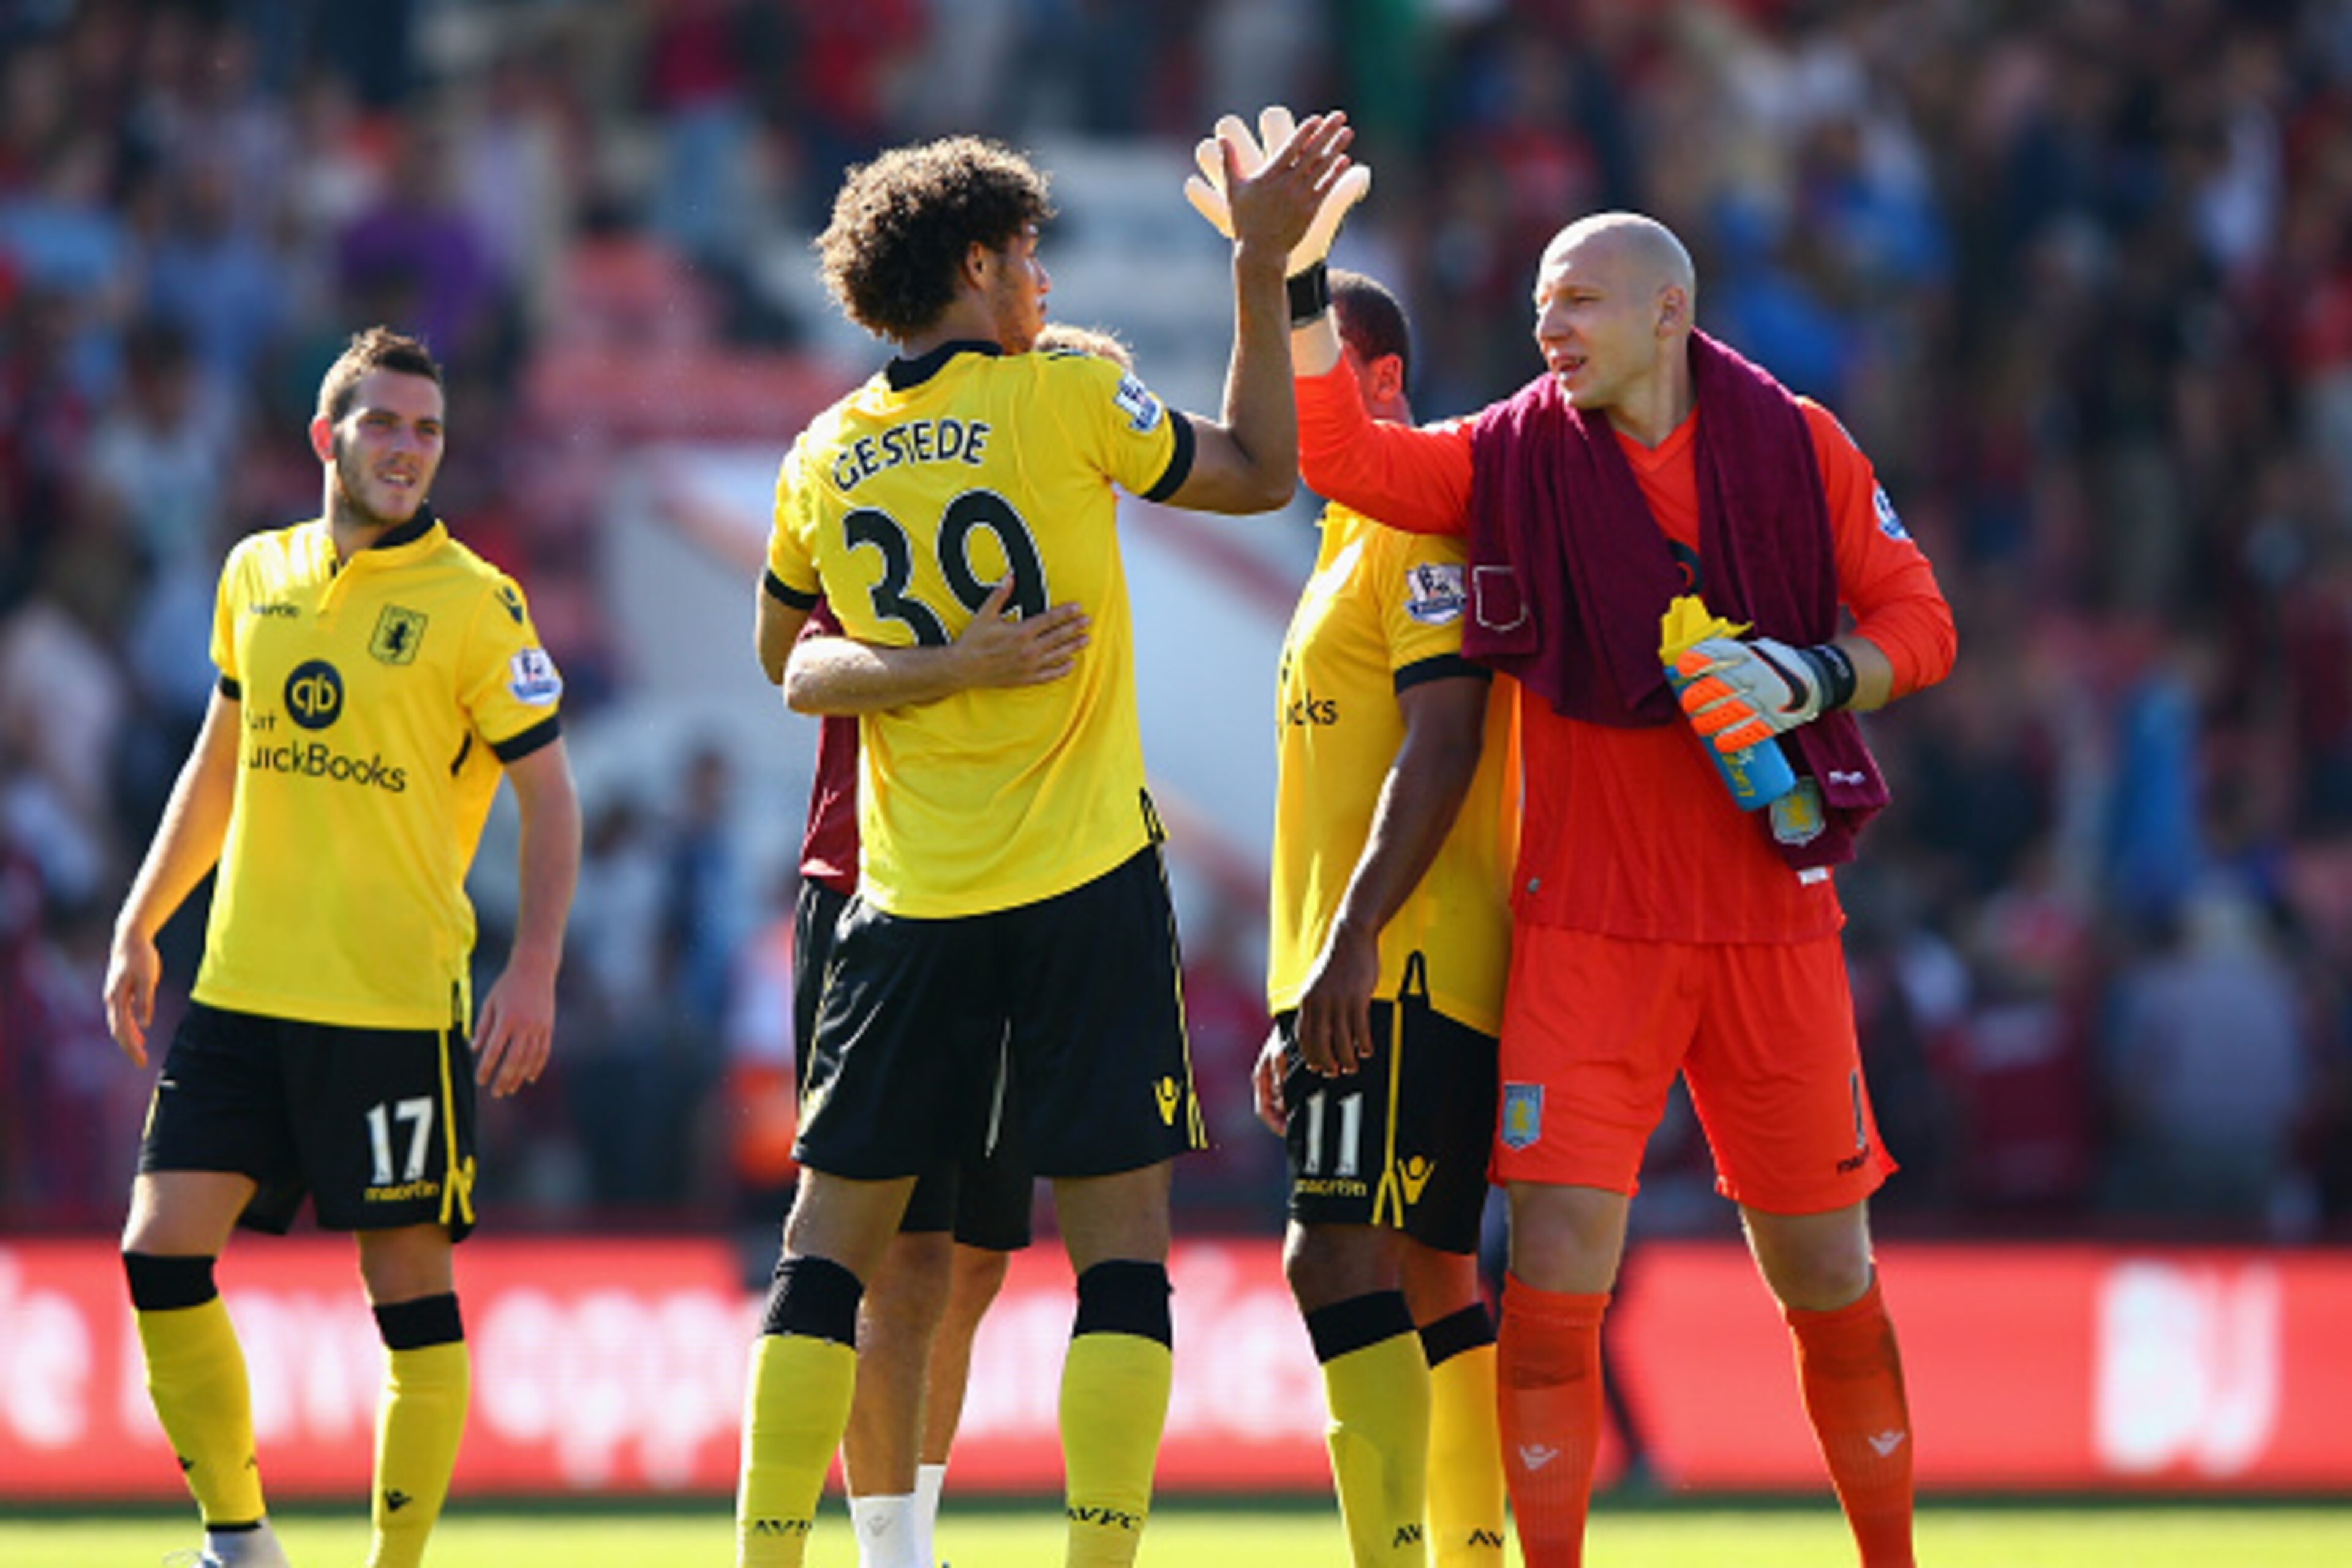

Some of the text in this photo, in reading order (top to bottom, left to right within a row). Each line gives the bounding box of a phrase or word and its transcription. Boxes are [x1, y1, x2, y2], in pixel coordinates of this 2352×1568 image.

[831, 418, 990, 492] GESTEDE
[842, 487, 1050, 646] 39
[366, 1095, 434, 1185] 17
[1304, 1088, 1363, 1176] 11
